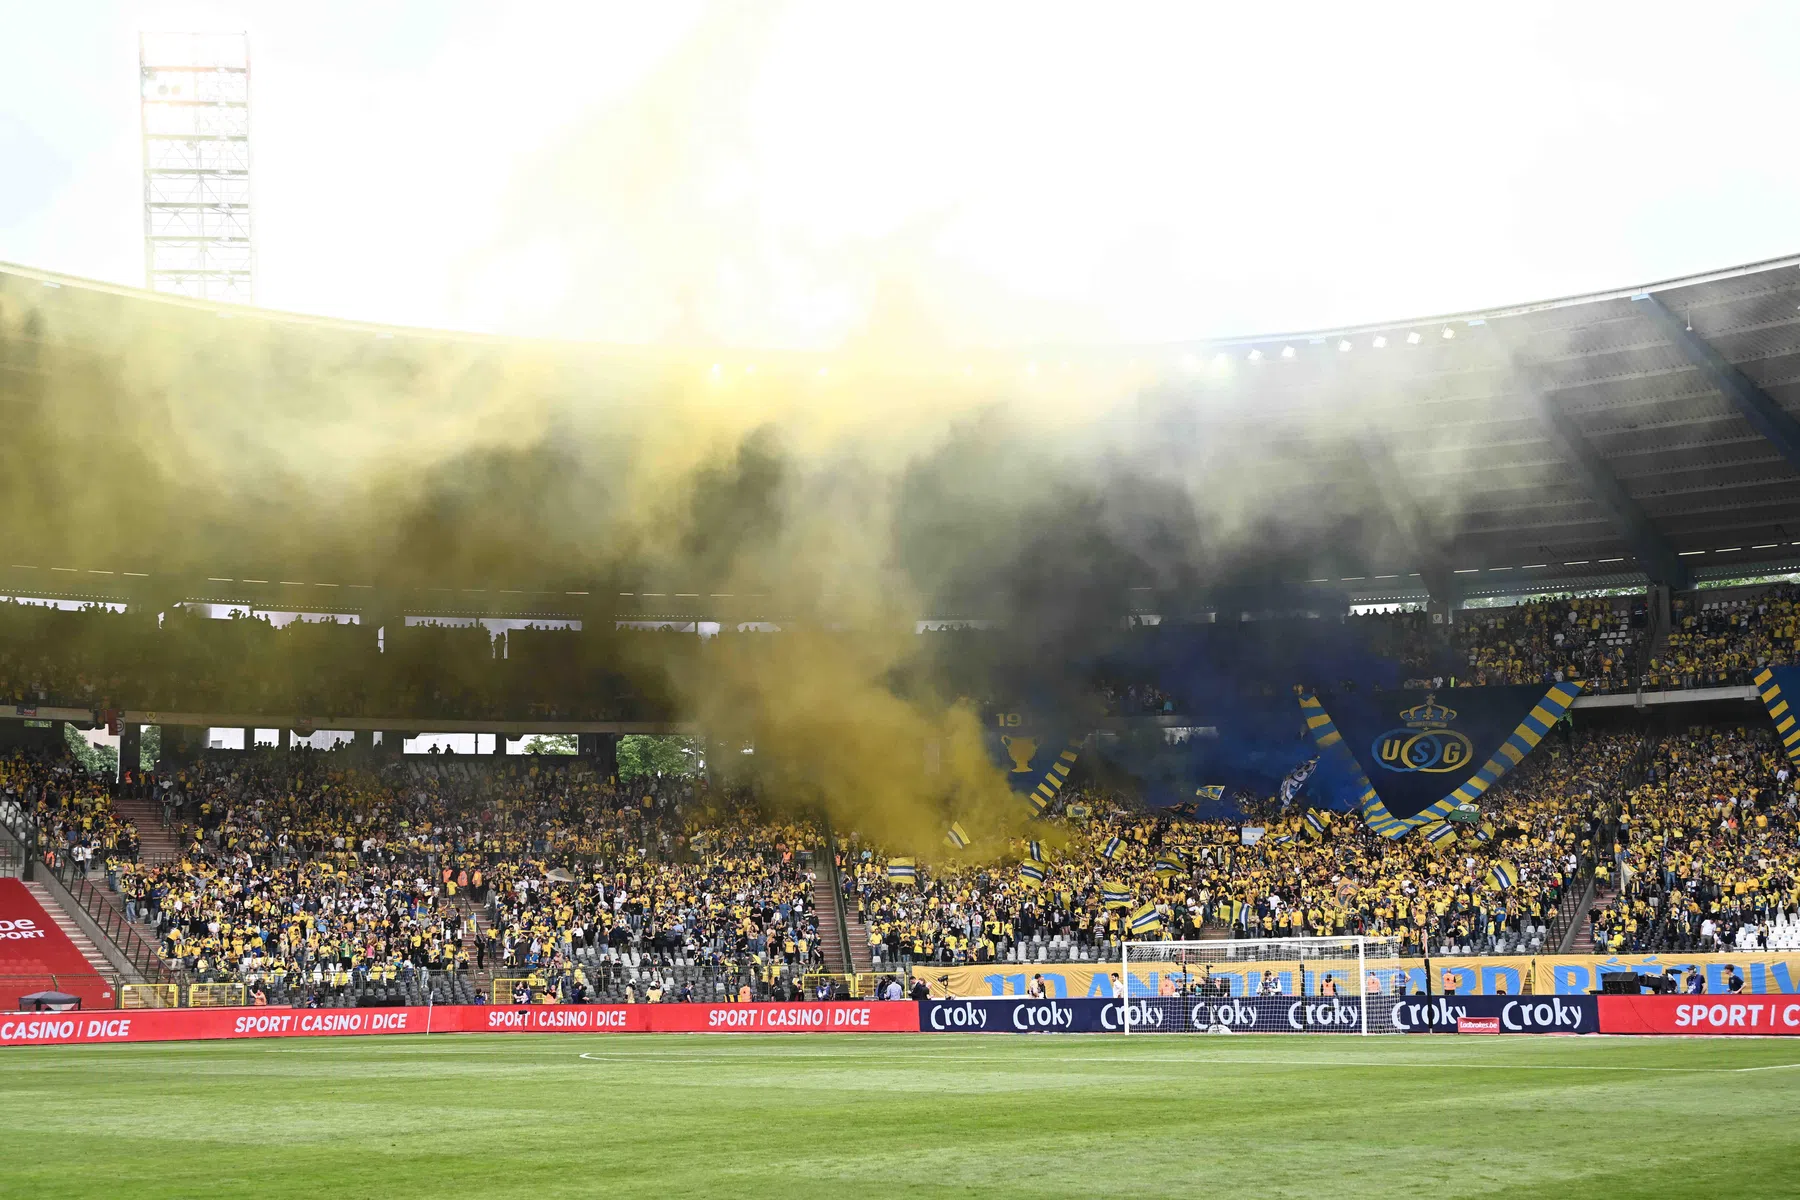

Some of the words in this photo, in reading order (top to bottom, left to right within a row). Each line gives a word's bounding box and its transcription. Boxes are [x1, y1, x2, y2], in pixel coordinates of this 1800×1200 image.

[1382, 739, 1461, 764] USG
[234, 1015, 291, 1033] SPORT
[301, 1014, 362, 1031] CASINO
[372, 1013, 408, 1029] DICE
[488, 1011, 531, 1027] SPORT
[538, 1011, 587, 1027] CASINO
[596, 1010, 627, 1026] DICE
[708, 1009, 757, 1026] SPORT
[767, 1009, 824, 1026] CASINO
[833, 1008, 871, 1025] DICE
[930, 1002, 987, 1030] Croky
[1013, 1001, 1072, 1030] Croky
[1101, 1000, 1163, 1029] Croky
[1192, 999, 1257, 1029] Croky
[1288, 998, 1357, 1029] Croky
[1391, 998, 1467, 1029] Croky
[1460, 1021, 1498, 1029] Ladbrokes.be
[1502, 998, 1582, 1030] Croky
[1675, 1004, 1763, 1026] SPORT
[1, 1021, 75, 1040] CASINO
[87, 1019, 131, 1038] DICE
